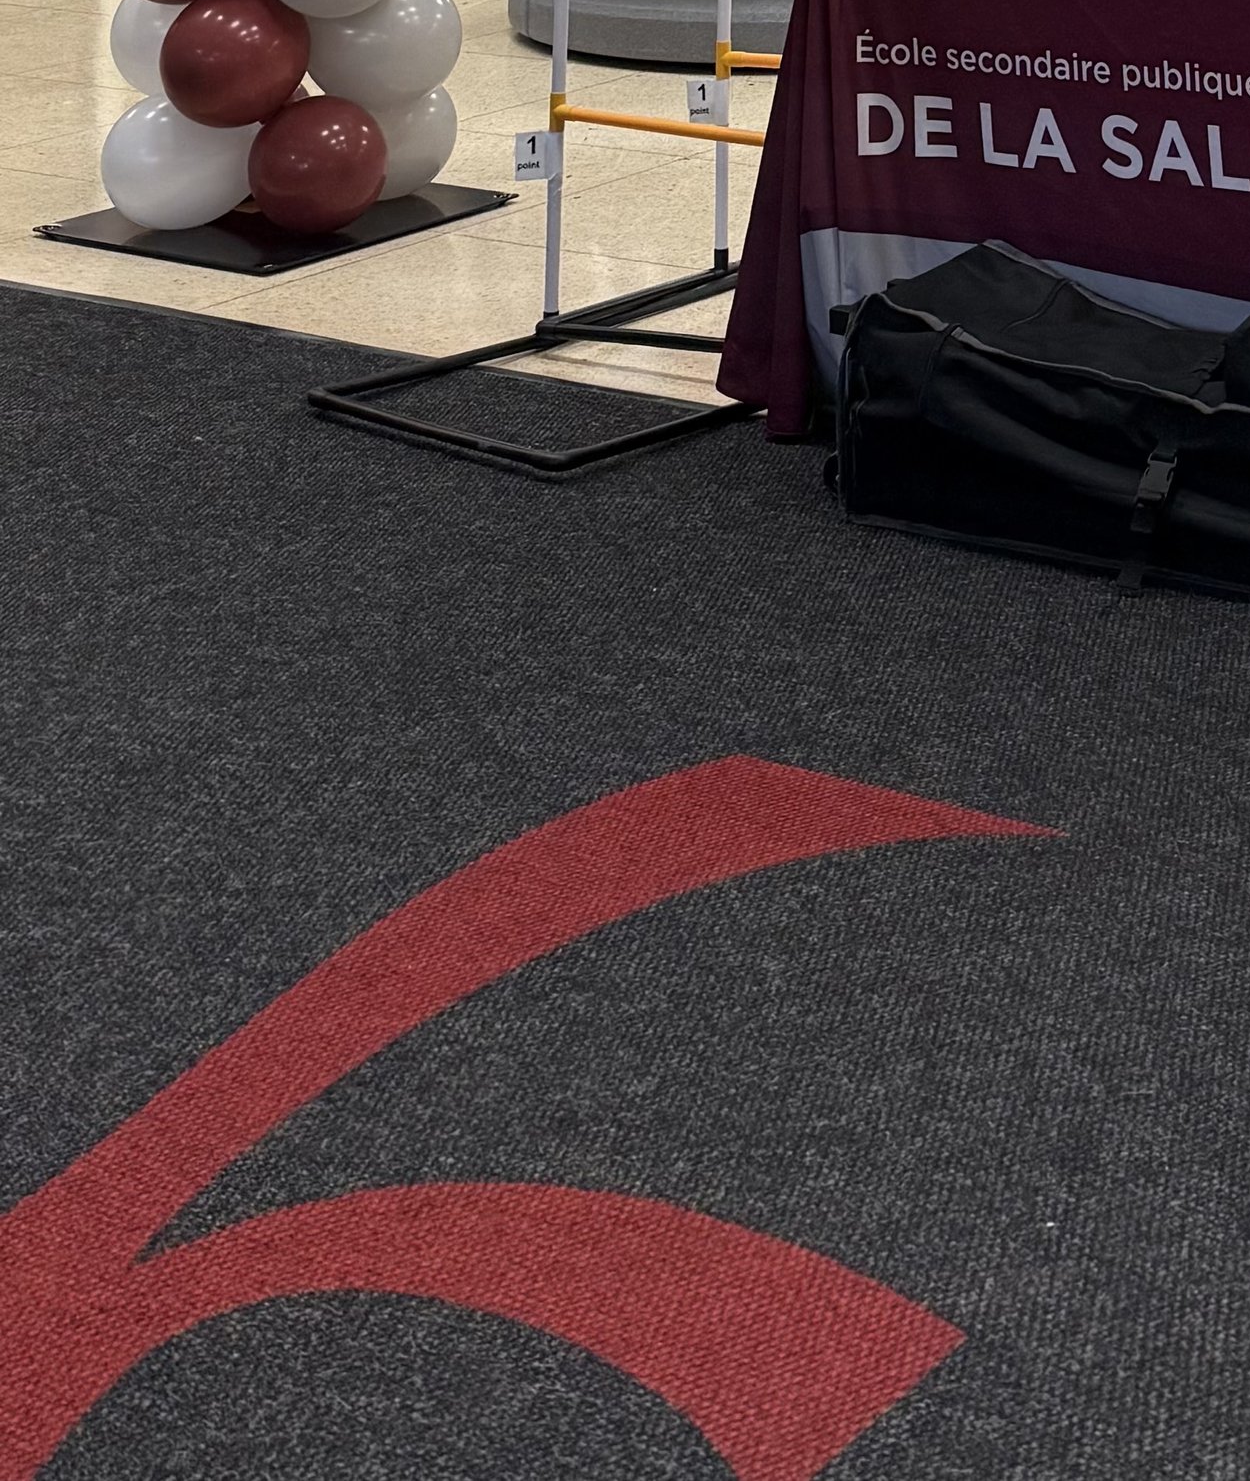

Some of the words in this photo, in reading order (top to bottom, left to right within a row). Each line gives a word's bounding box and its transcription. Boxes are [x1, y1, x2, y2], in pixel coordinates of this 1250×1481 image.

[856, 30, 937, 67] École
[947, 50, 1110, 84] secondaire
[698, 83, 706, 101] 1
[690, 106, 710, 115] point
[857, 92, 958, 158] DE
[980, 102, 1077, 173] LA
[527, 135, 536, 154] 1
[517, 160, 540, 171] point
